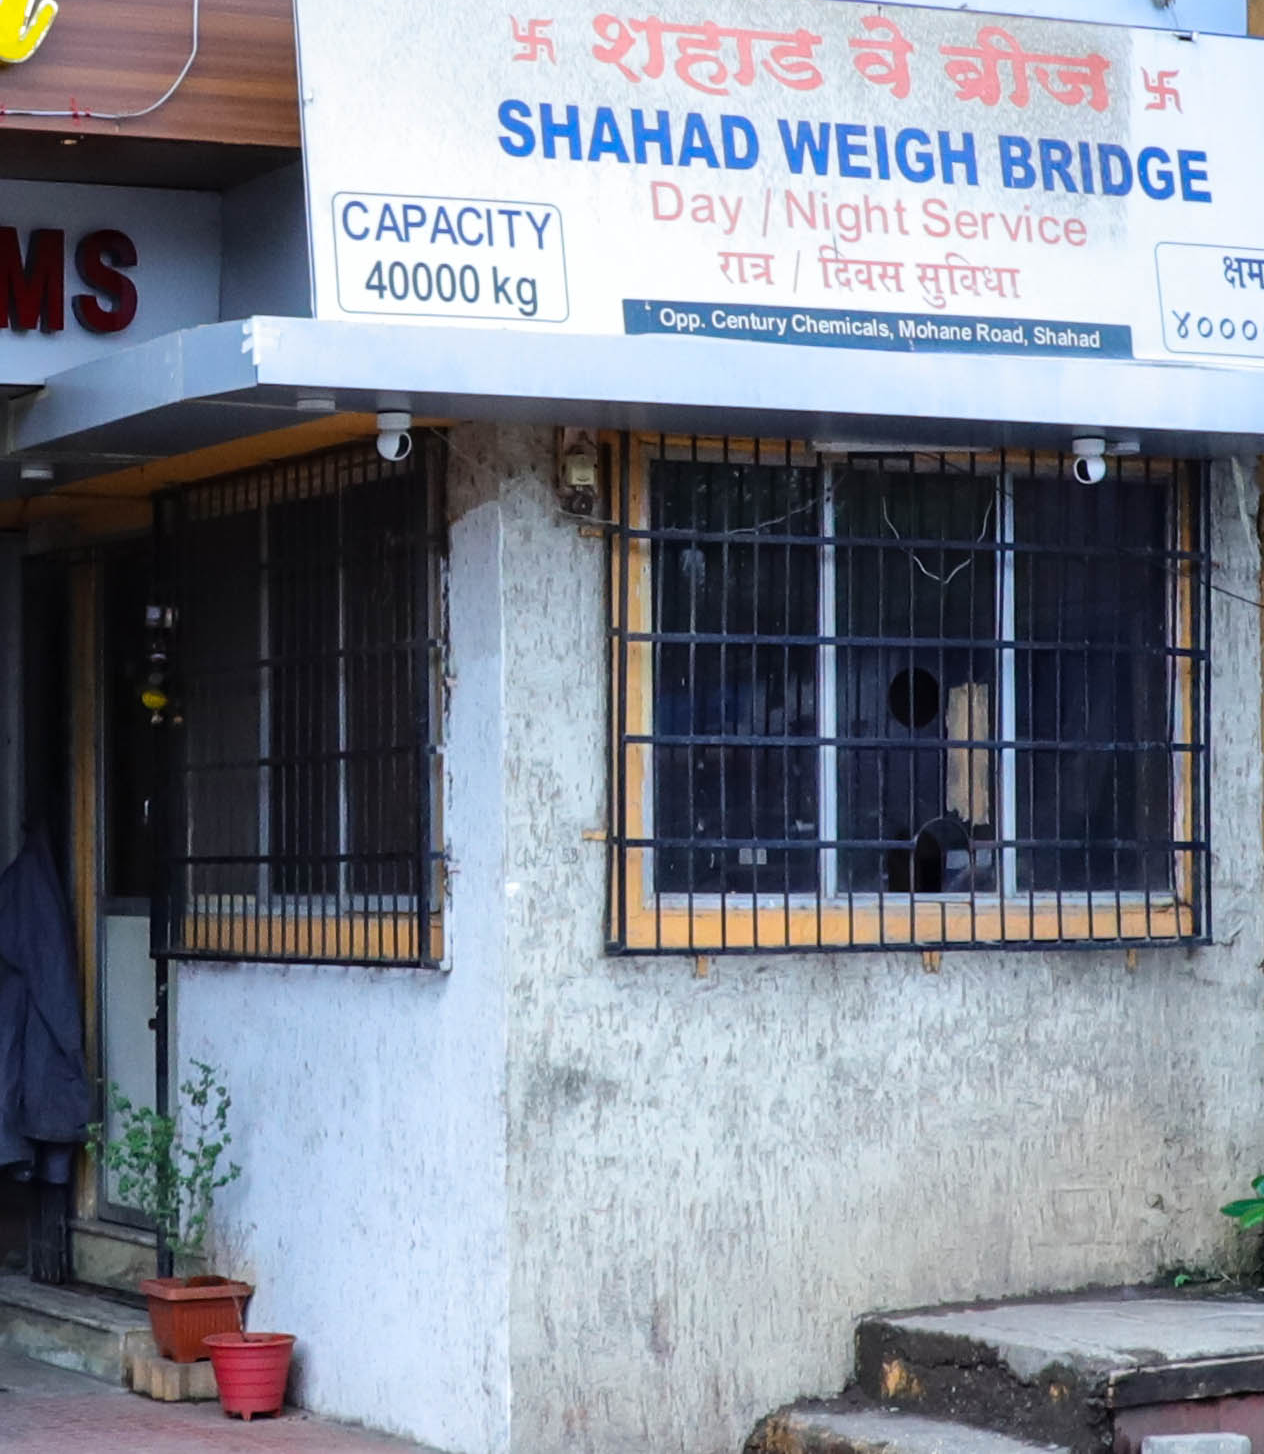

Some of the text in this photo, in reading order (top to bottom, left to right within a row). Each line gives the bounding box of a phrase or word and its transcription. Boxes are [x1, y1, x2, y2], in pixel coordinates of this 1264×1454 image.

[591, 13, 1111, 113] शहाड वे ब्रीज
[498, 99, 1212, 203] SHAHAD WEIGH BRIDGE
[342, 201, 551, 250] CAPACITY
[649, 181, 743, 236] Day
[785, 190, 909, 243] Night
[922, 197, 1088, 247] Service
[365, 260, 538, 317] 40000 kg
[818, 245, 904, 292] दिवस
[915, 252, 1020, 309] सुविधा
[659, 308, 1100, 348] Opp. Century Chemicals, Mohane Road, Shahad
